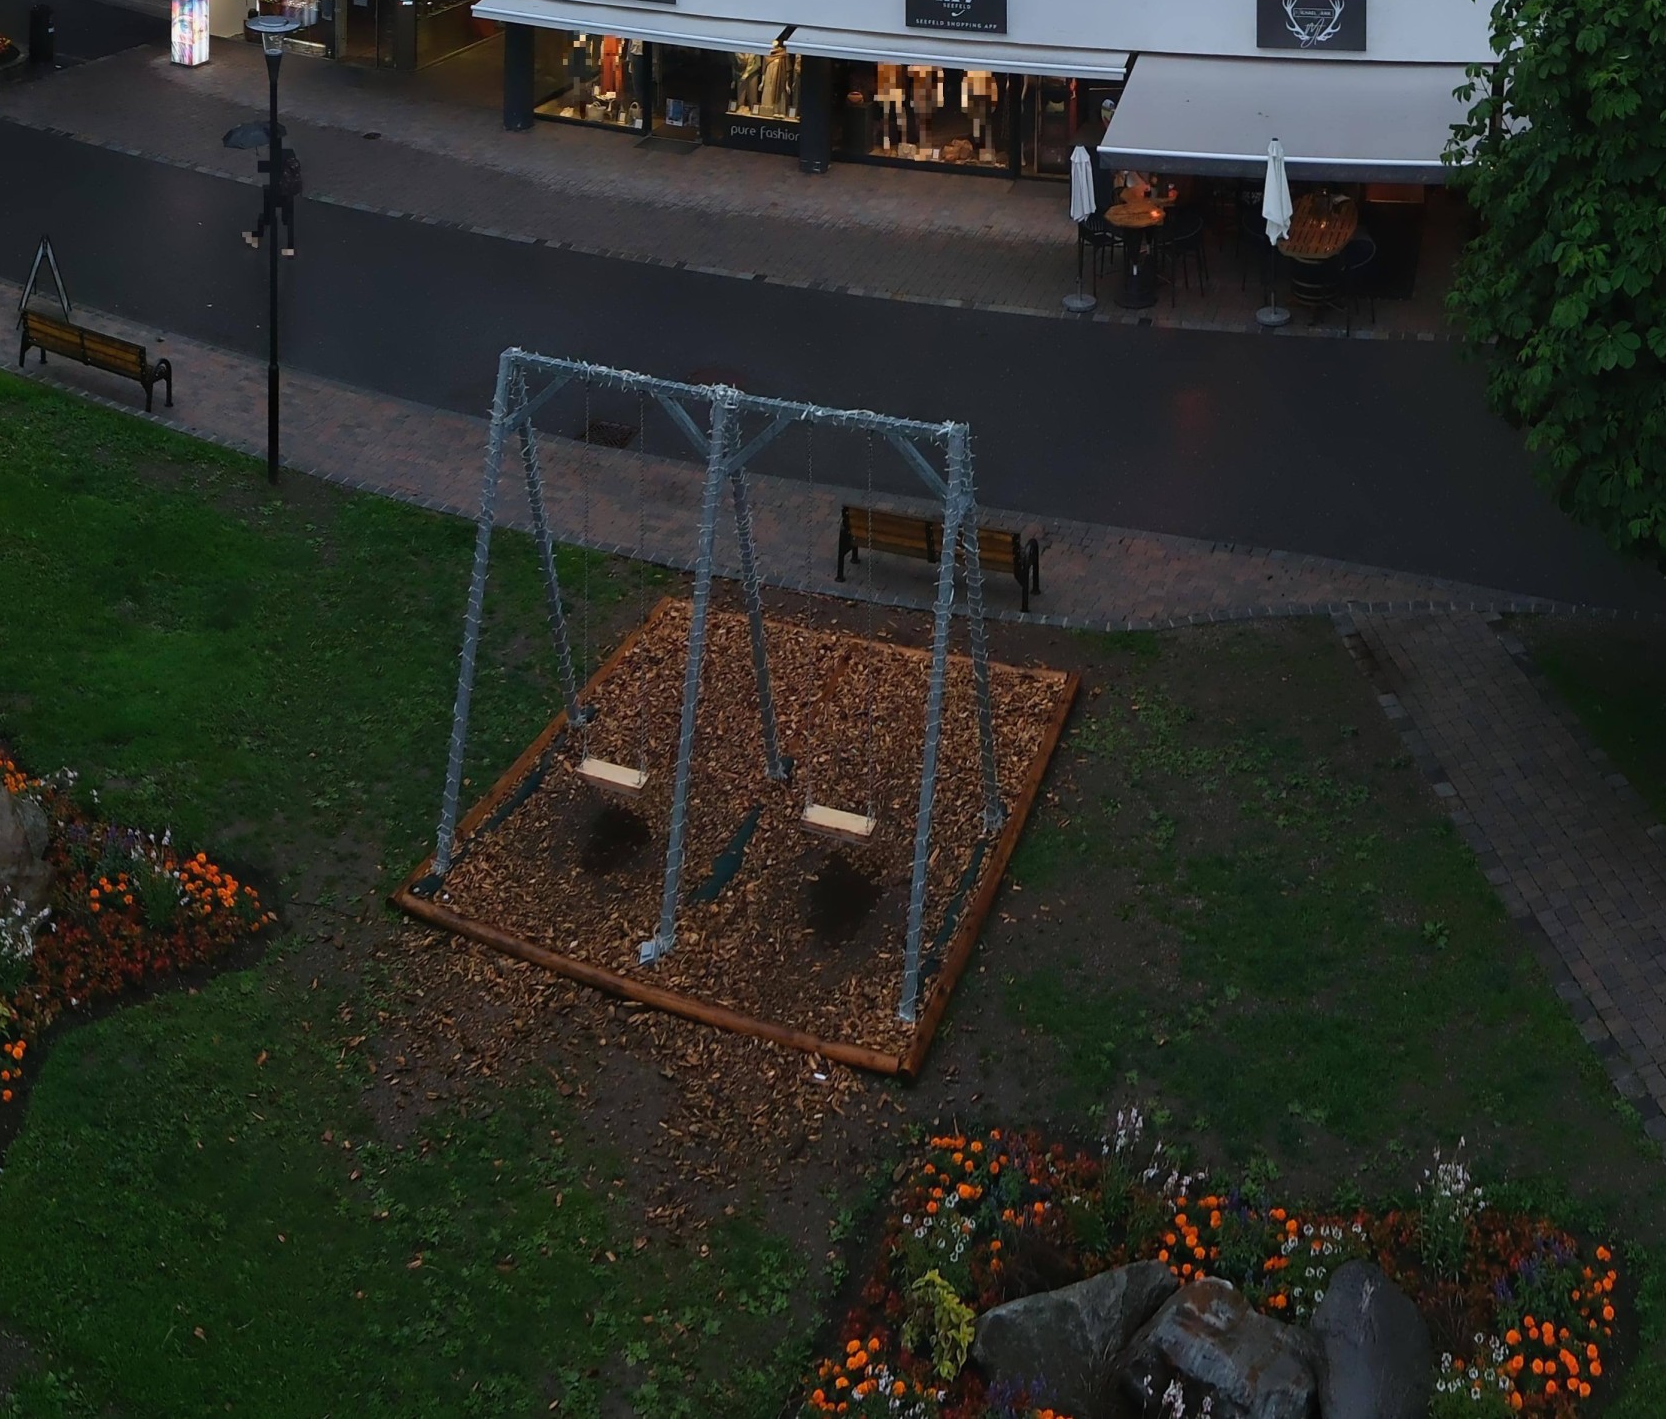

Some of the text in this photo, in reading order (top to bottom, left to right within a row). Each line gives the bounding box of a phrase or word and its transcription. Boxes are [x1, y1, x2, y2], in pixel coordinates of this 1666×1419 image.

[943, 2, 972, 10] SEEFELD
[915, 18, 944, 26] SEEFELD
[946, 20, 982, 29] SHOPPING
[730, 124, 757, 136] pure
